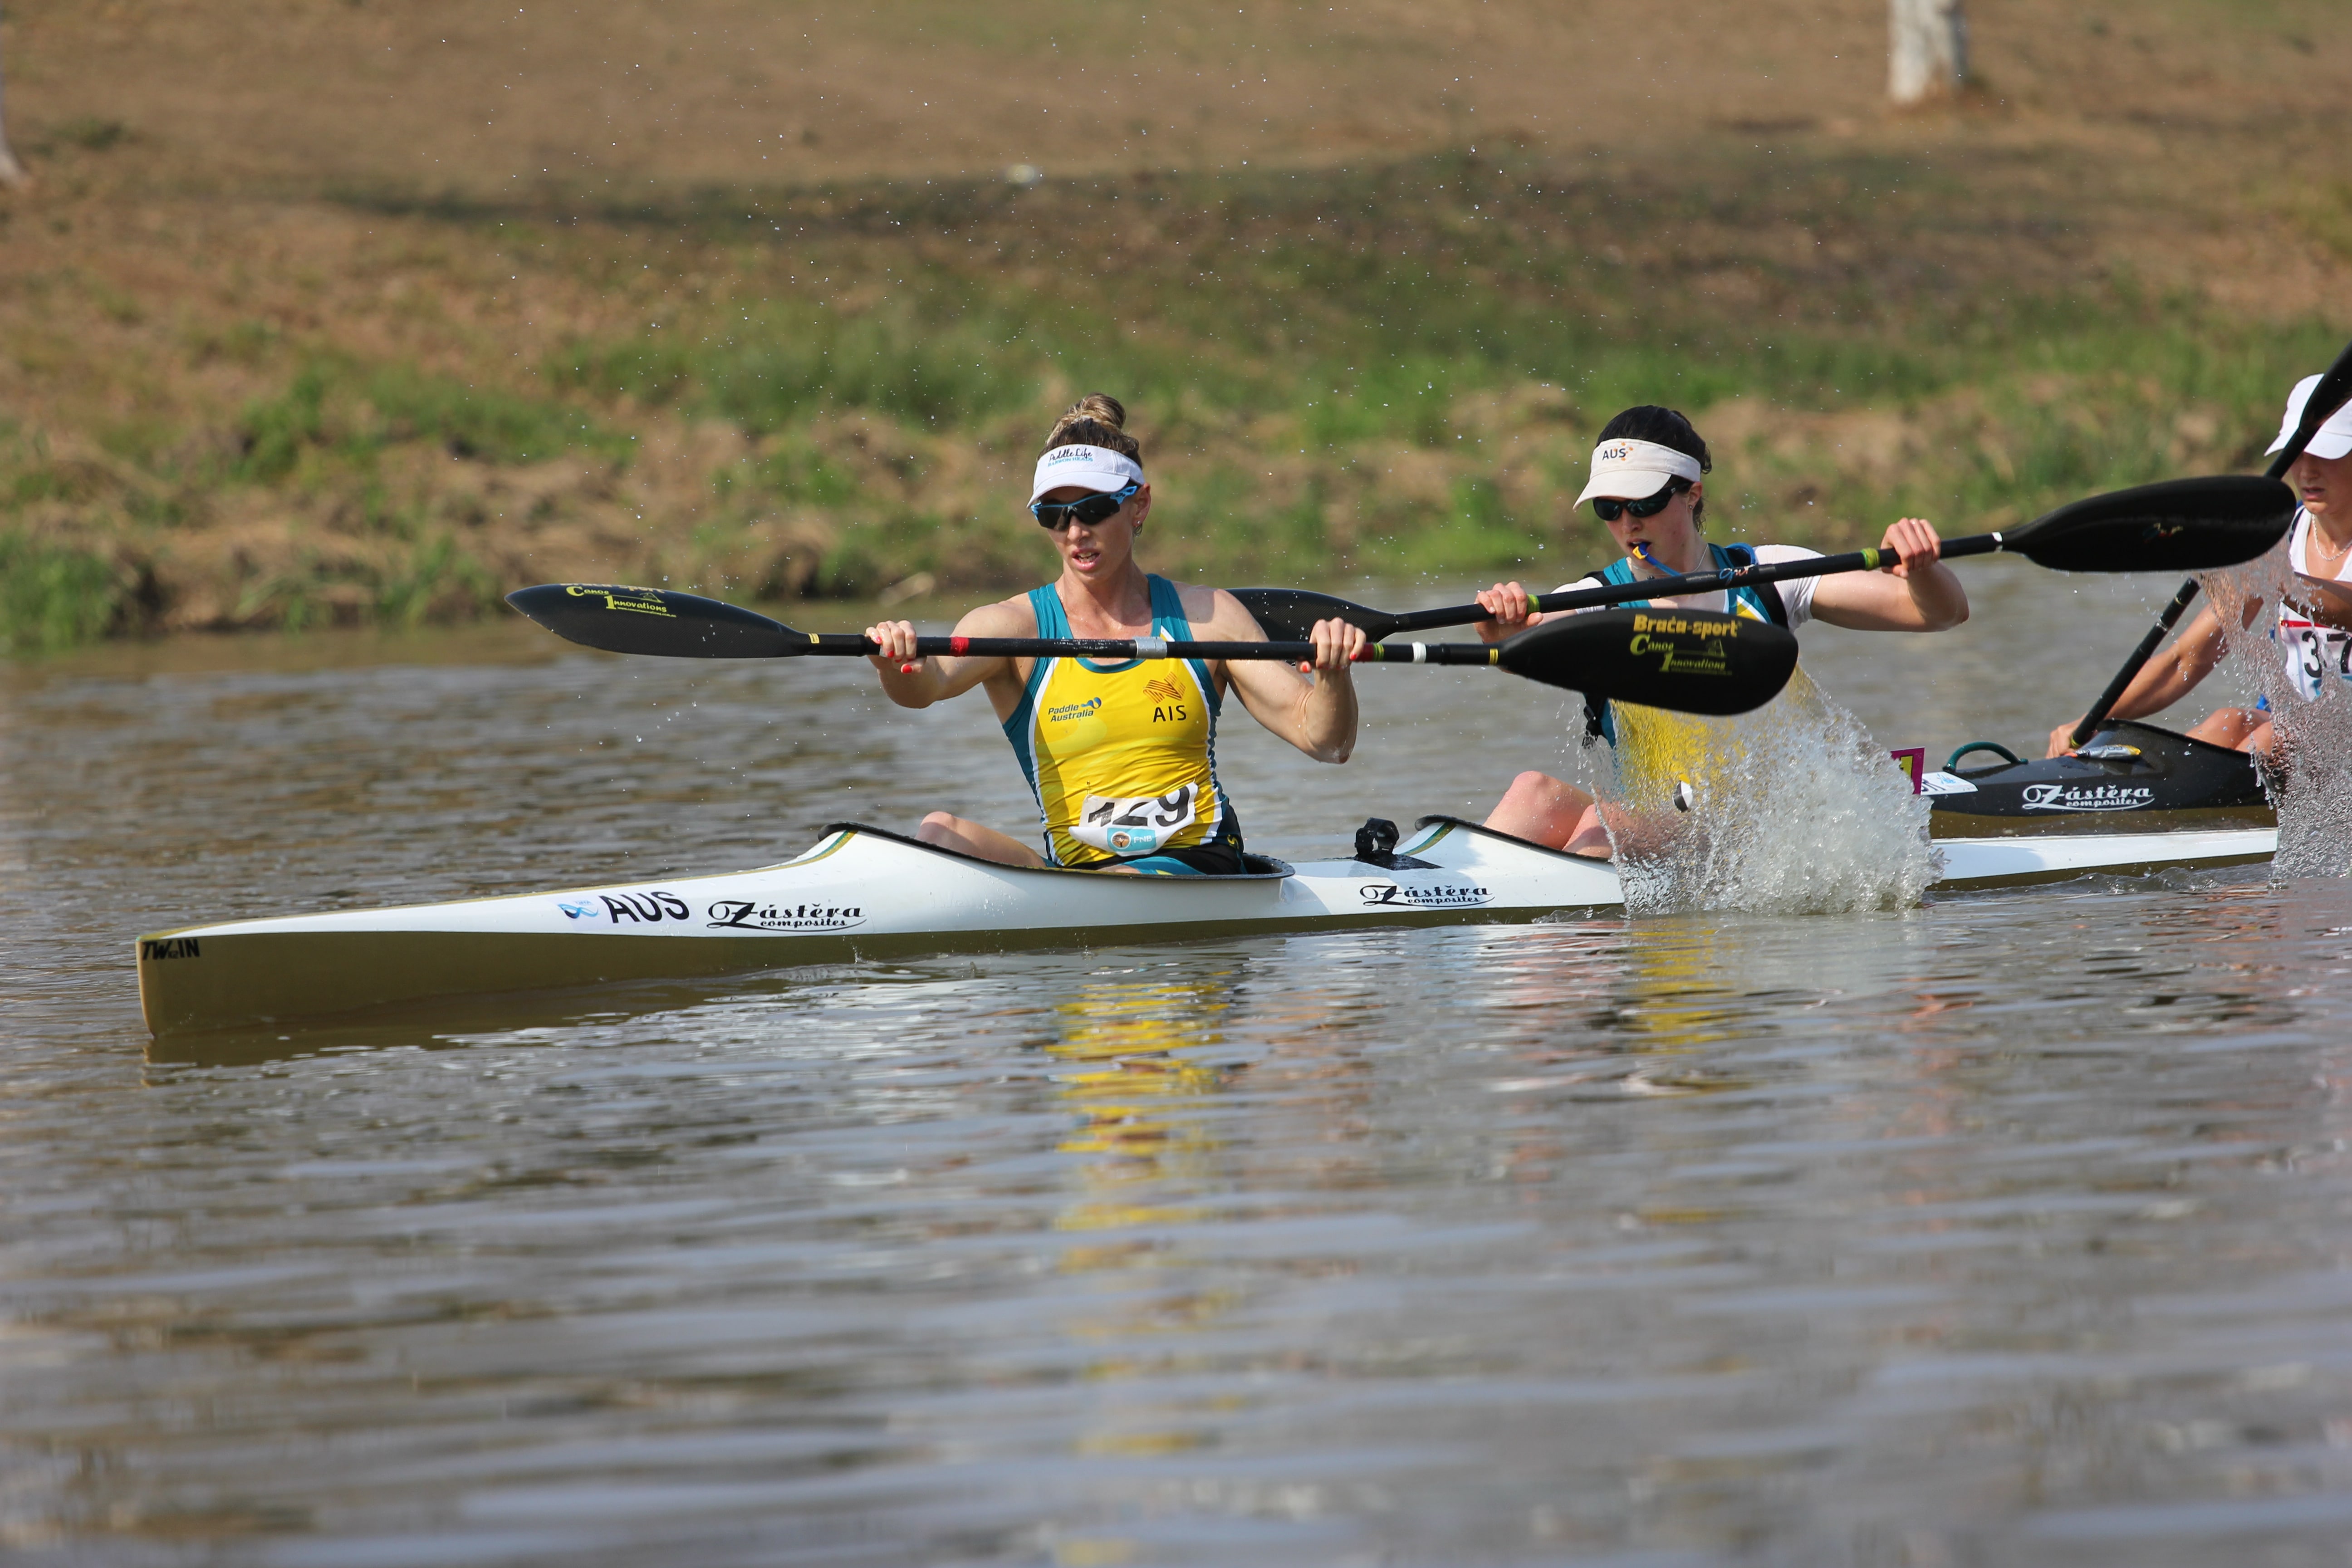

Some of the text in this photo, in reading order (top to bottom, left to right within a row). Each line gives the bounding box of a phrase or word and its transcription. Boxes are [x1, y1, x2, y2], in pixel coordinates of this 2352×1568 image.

[1049, 448, 1093, 462] Paddle Life
[1602, 448, 1627, 461] AUS
[566, 586, 610, 597] Canoe
[604, 595, 667, 612] Innovations
[1630, 633, 1674, 657] Canoe
[1659, 652, 1726, 672] Innovations
[1048, 704, 1079, 715] Paddle
[1050, 709, 1094, 723] Australia
[1153, 705, 1187, 722] AIS
[2022, 784, 2154, 810] Zástěra
[2066, 797, 2139, 808] composites
[1088, 786, 1191, 827] 129
[1133, 835, 1153, 843] FNB
[1360, 885, 1494, 906] Zástěra
[1407, 896, 1481, 905] composites
[598, 891, 690, 924] AUS
[706, 901, 866, 930] Zástěra
[760, 918, 848, 929] composites
[142, 939, 201, 960] TWIN
